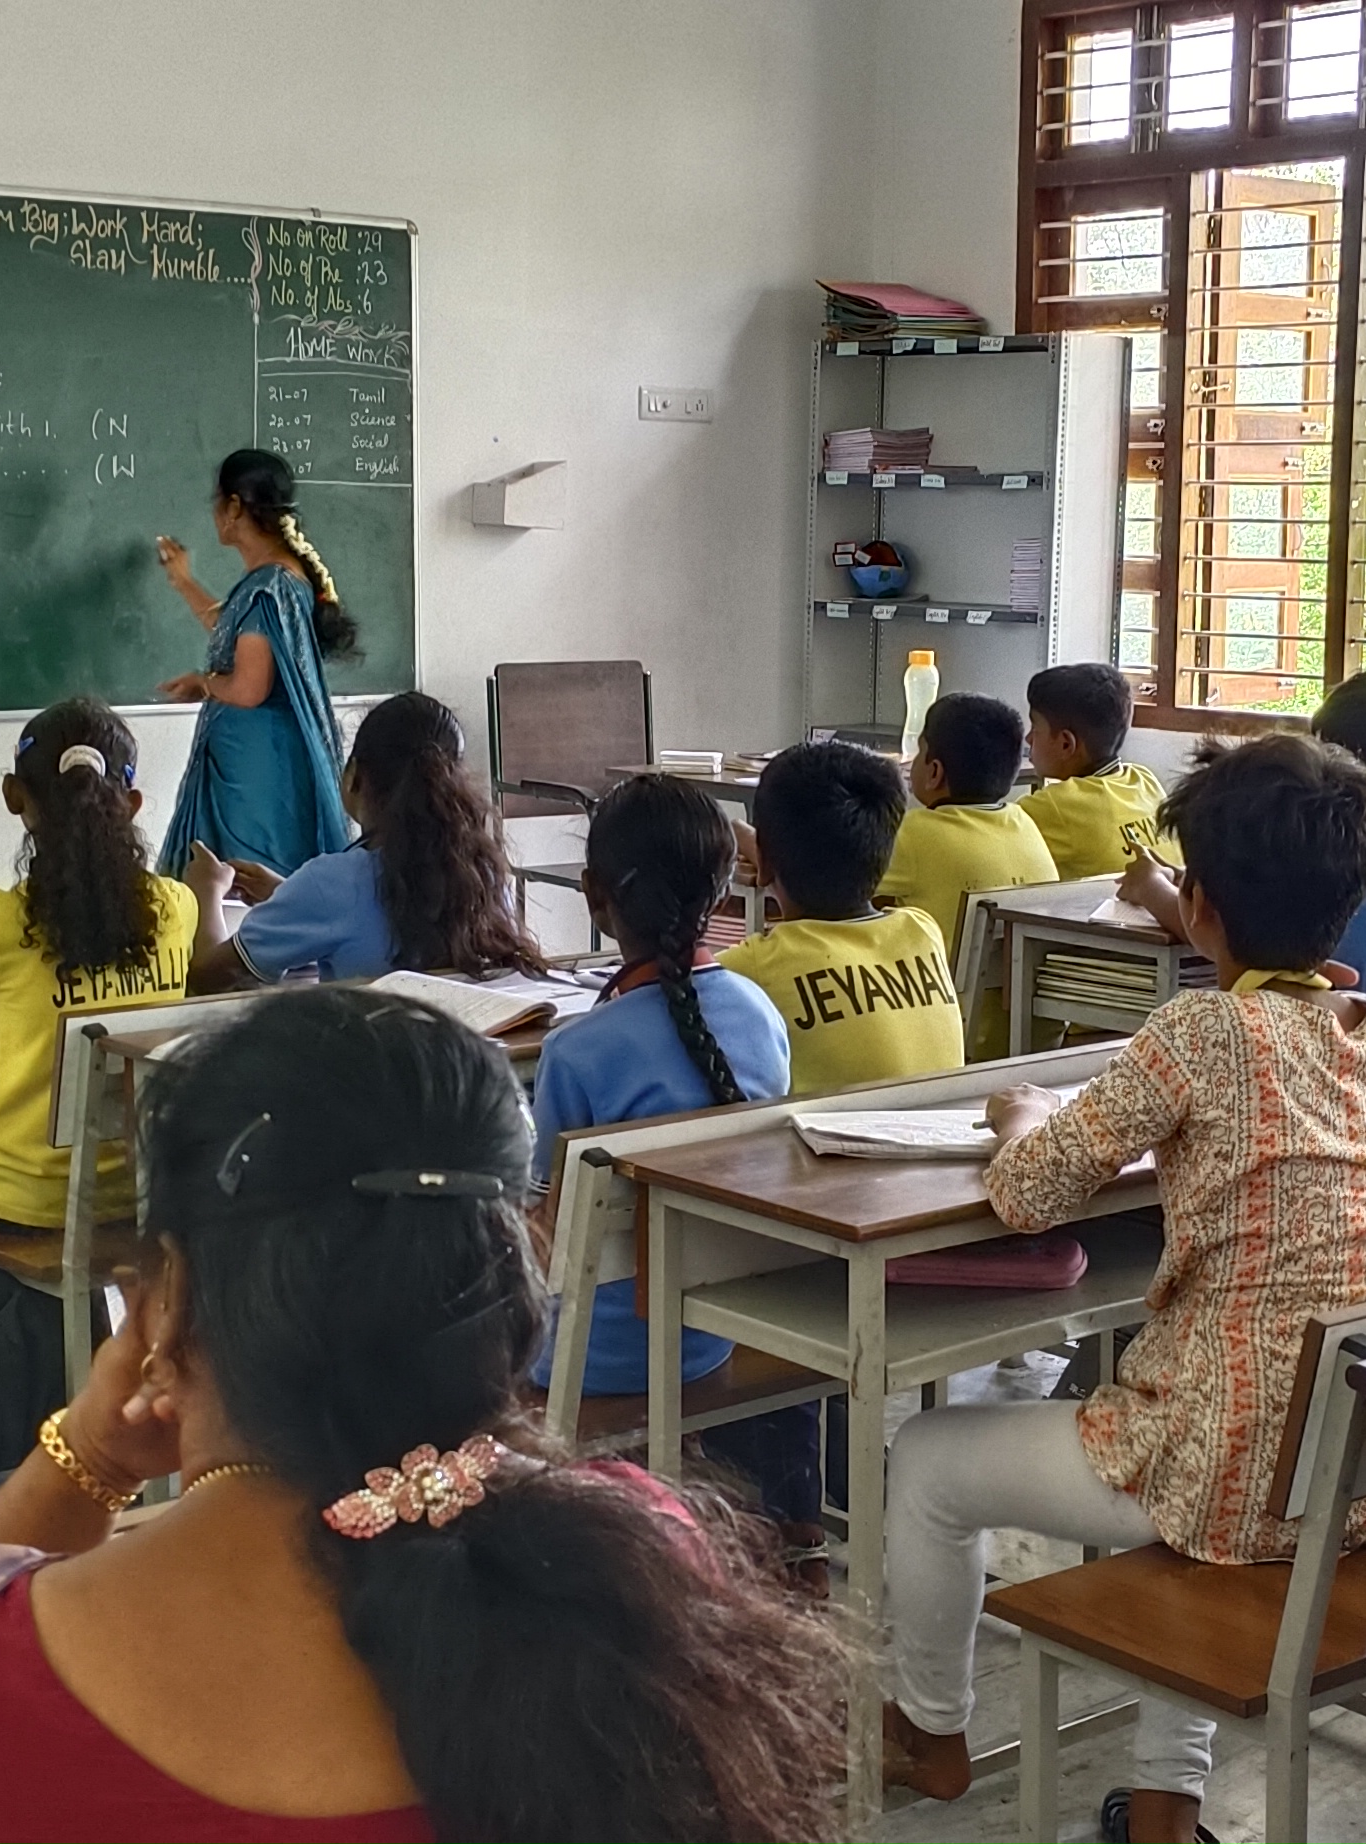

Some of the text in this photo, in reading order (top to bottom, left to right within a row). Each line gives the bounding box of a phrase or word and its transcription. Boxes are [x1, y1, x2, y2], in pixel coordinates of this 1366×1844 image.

[71, 205, 135, 248] Work
[315, 225, 351, 256] Roll
[70, 239, 126, 278] Stay
[299, 252, 313, 288] of
[316, 255, 344, 286] Pre
[304, 285, 319, 317] of
[323, 286, 353, 313] Abs
[268, 386, 385, 404] 21-07 Tamil
[349, 408, 397, 428] Science
[352, 433, 389, 449] Social
[355, 455, 400, 480] English
